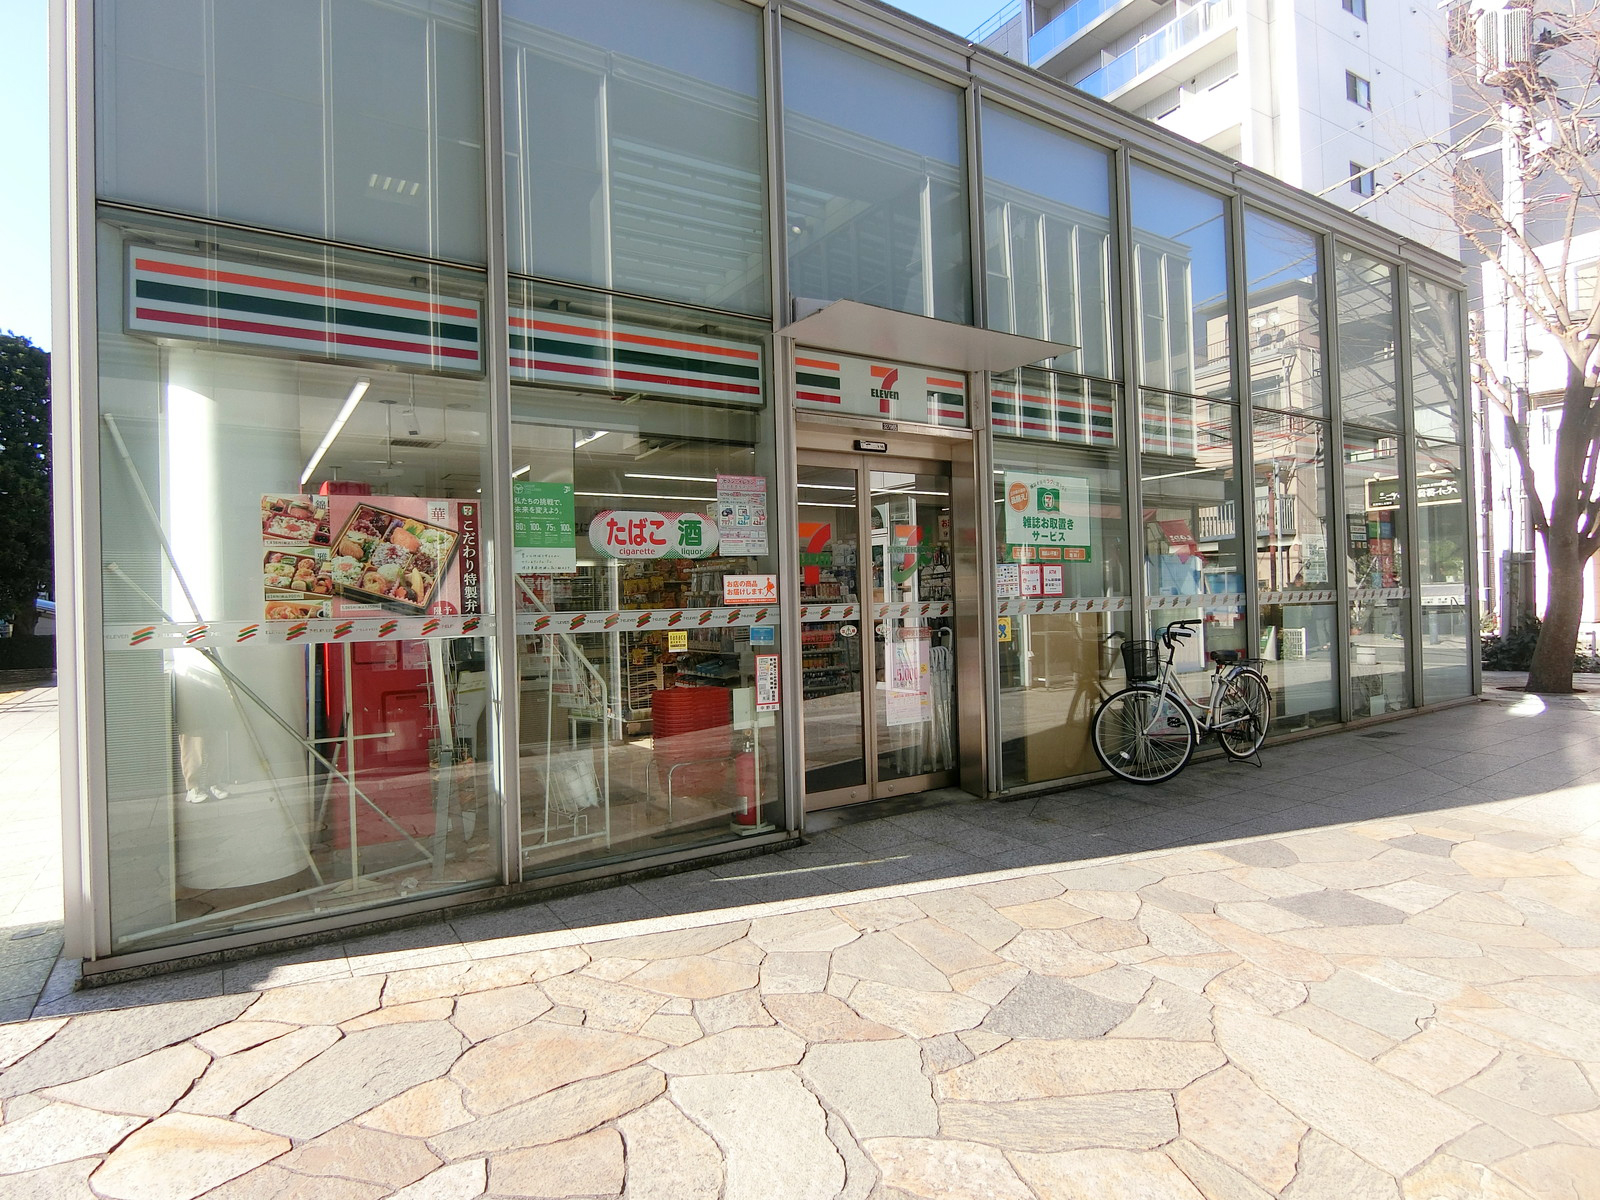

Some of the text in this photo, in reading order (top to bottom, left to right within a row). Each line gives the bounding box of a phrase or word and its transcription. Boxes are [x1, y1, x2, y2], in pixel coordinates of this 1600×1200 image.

[431, 507, 446, 521] 華
[1022, 516, 1074, 530] 雑誌お取置き
[606, 517, 667, 546] たばこ
[677, 519, 702, 546] 酒
[1032, 531, 1066, 541] サービス
[619, 547, 703, 556] cigarette liquor
[462, 520, 478, 615] こだわり特製弁
